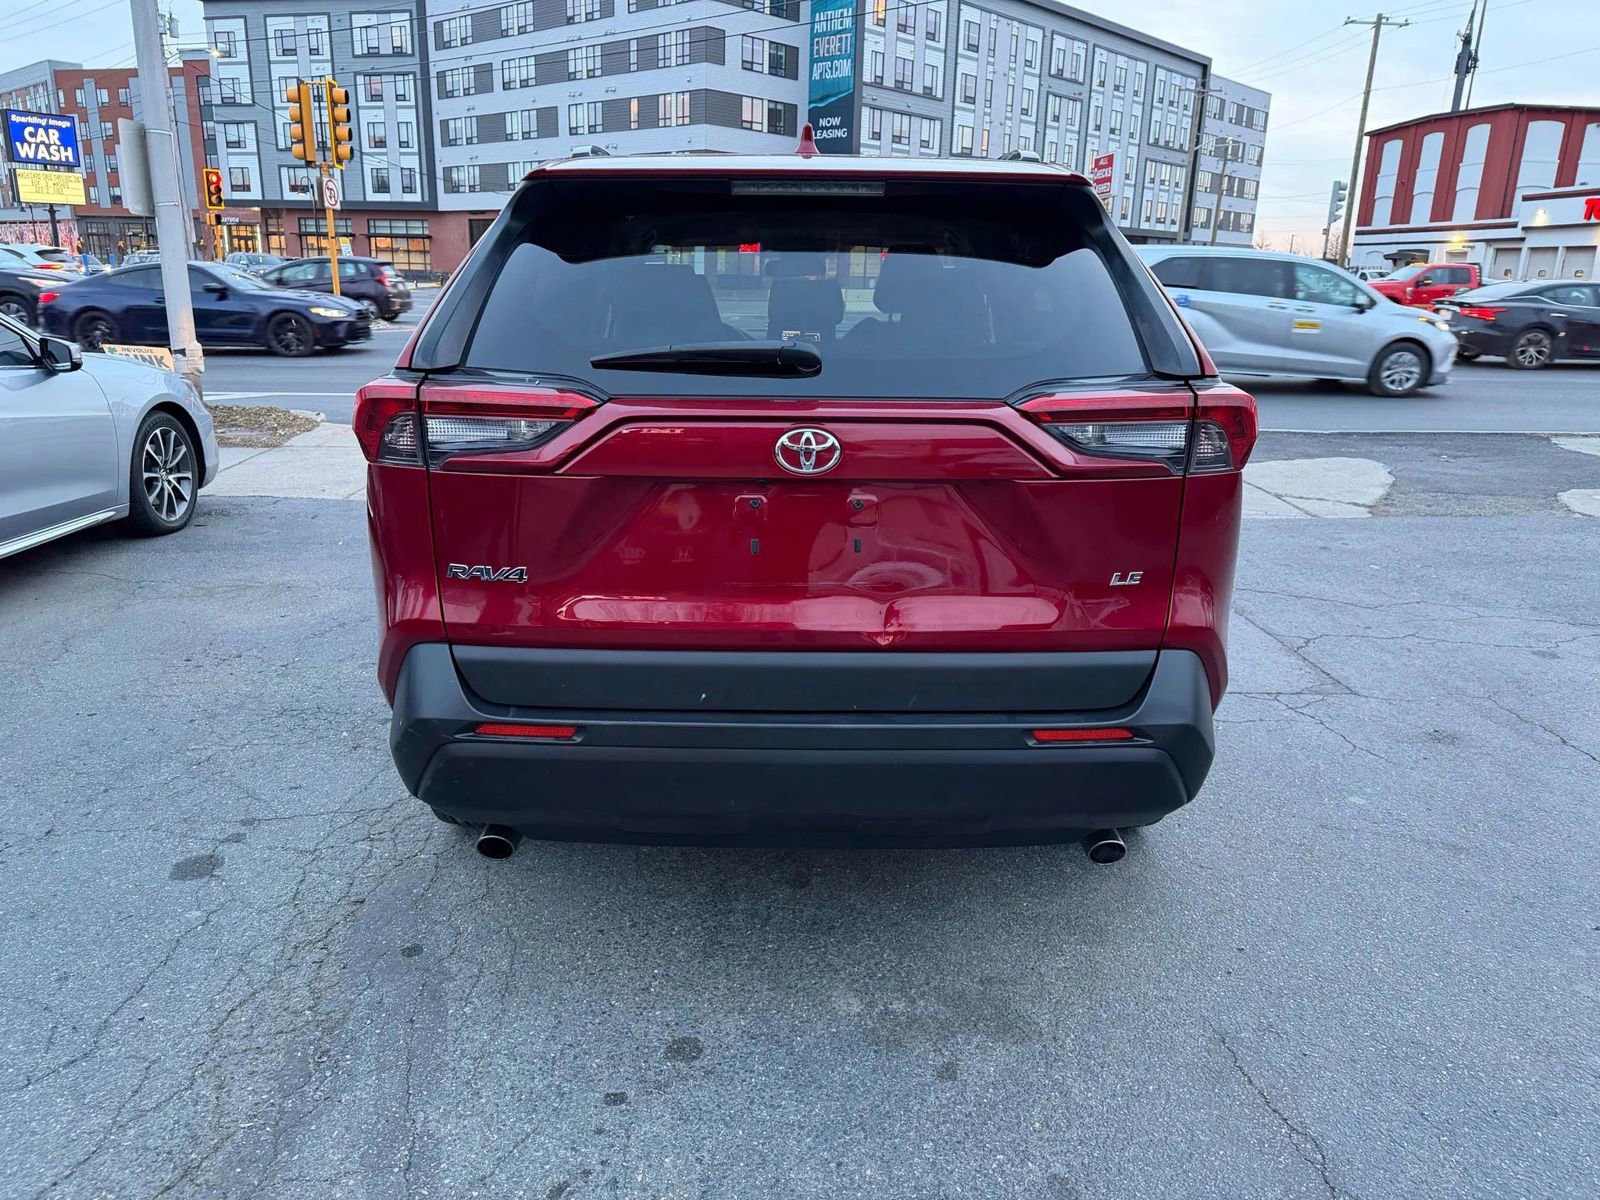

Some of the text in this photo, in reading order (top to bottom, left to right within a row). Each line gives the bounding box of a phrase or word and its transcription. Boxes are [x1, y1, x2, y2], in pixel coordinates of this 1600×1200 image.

[814, 8, 852, 33] ANTHEM
[814, 33, 852, 57] EVERETT
[812, 59, 852, 81] APTS.COM
[11, 114, 47, 126] Sparkling
[819, 116, 841, 127] NOW
[24, 126, 61, 145] CAR
[814, 128, 847, 139] LEASING
[16, 142, 74, 162] WASH
[446, 563, 529, 584] RAV4
[1109, 571, 1144, 586] LE
